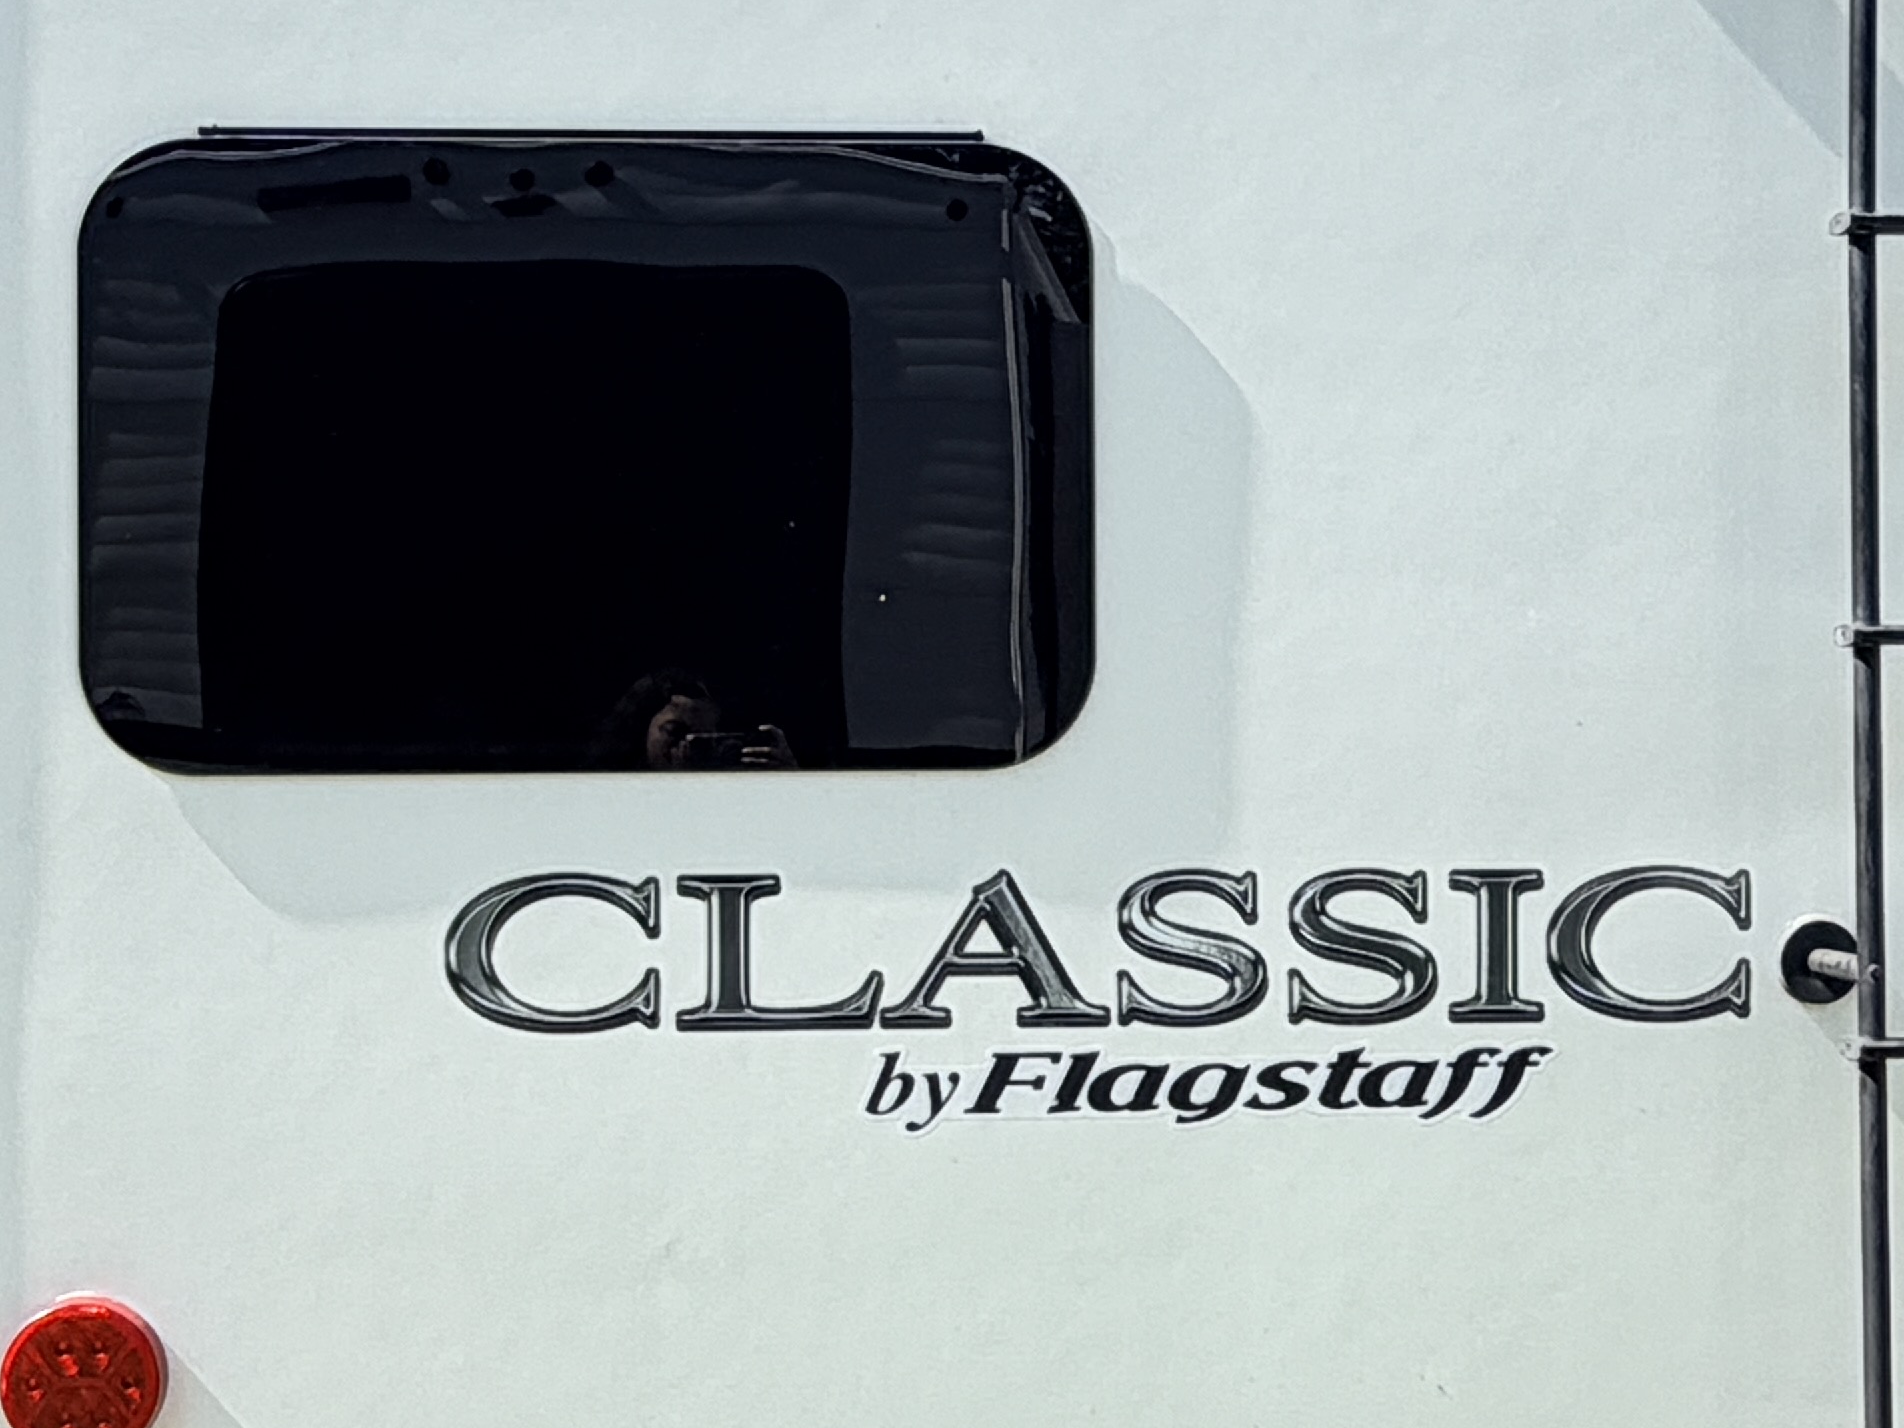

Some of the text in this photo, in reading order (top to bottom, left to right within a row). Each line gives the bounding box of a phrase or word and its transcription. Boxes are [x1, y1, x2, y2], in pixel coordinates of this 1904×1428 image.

[442, 865, 1753, 1034] CLASSIC
[864, 1046, 1553, 1132] by Flagstaff
